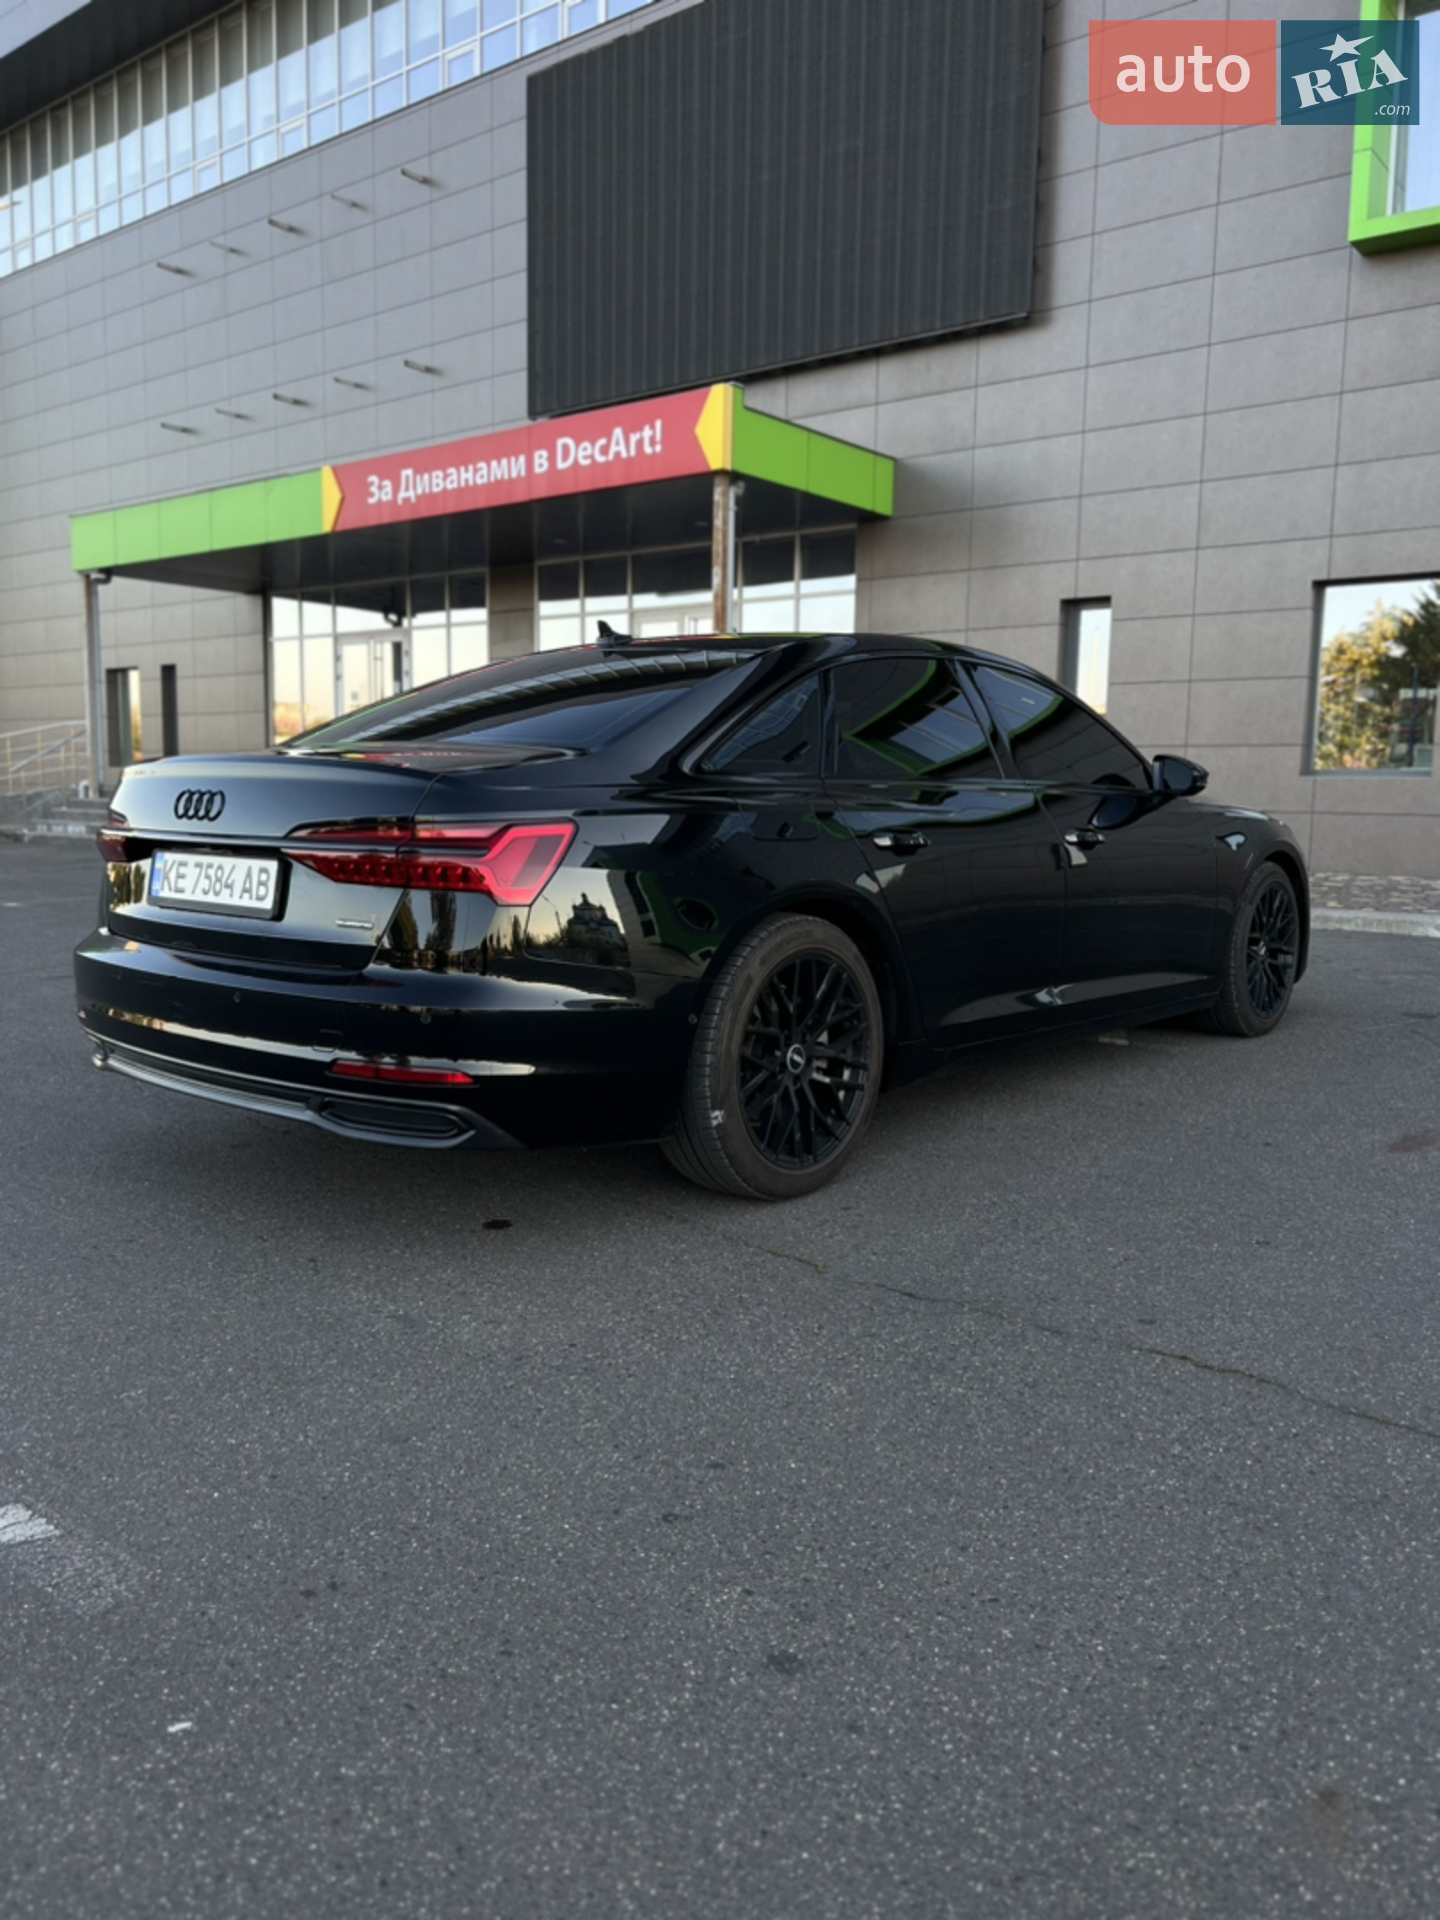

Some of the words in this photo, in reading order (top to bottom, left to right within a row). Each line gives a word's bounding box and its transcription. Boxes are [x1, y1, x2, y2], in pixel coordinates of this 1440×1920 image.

[367, 475, 393, 504] За
[397, 454, 526, 505] Диванами
[534, 449, 549, 474] в
[556, 419, 662, 470] DecArt!
[160, 859, 188, 894] KE
[191, 861, 237, 898] 7584
[238, 865, 271, 902] AB
